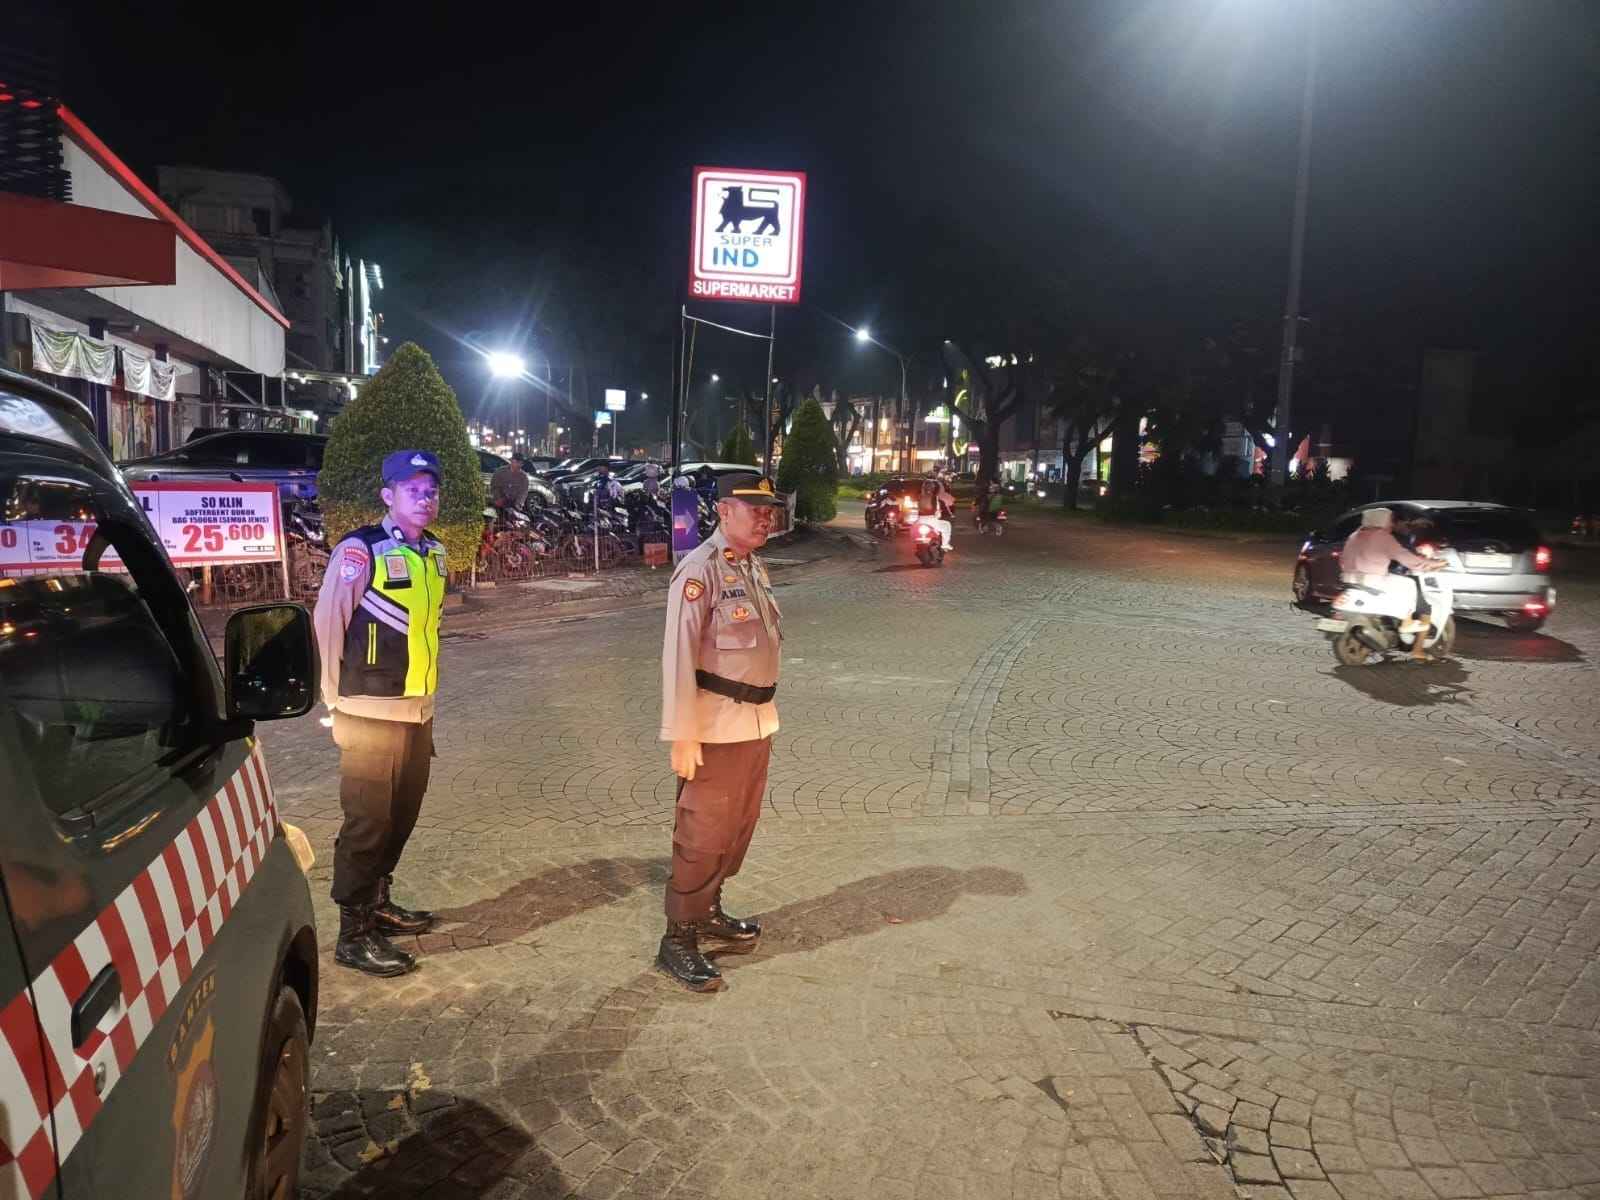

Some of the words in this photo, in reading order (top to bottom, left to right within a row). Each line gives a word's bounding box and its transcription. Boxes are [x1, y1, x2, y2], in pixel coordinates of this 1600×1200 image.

[720, 234, 773, 247] SUPER
[693, 280, 796, 299] SUPERMARKET
[201, 496, 216, 508] SO
[219, 496, 243, 508] KLIN
[182, 523, 265, 553] 25.600
